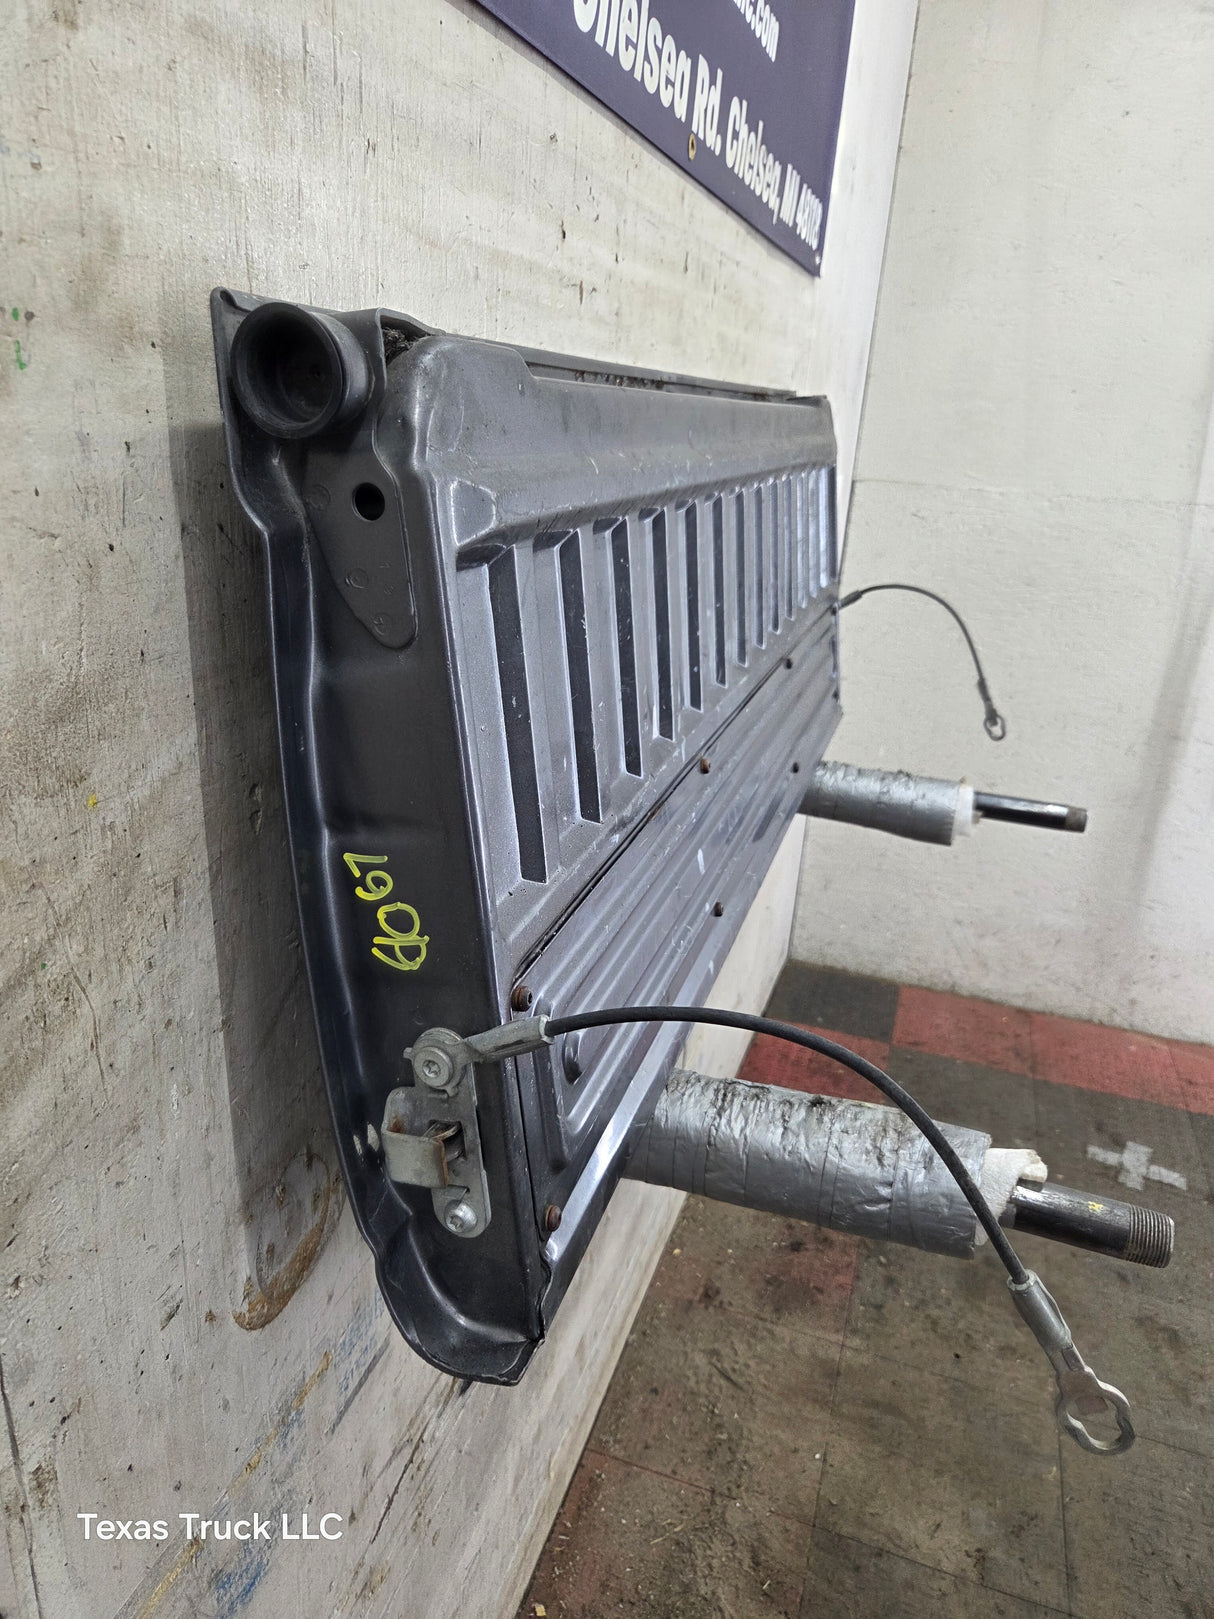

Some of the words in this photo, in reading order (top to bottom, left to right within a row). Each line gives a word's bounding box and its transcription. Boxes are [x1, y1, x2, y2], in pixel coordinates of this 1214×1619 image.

[573, 0, 692, 123] elsea
[691, 54, 723, 156] Rd.
[725, 96, 782, 225] Chelsea,
